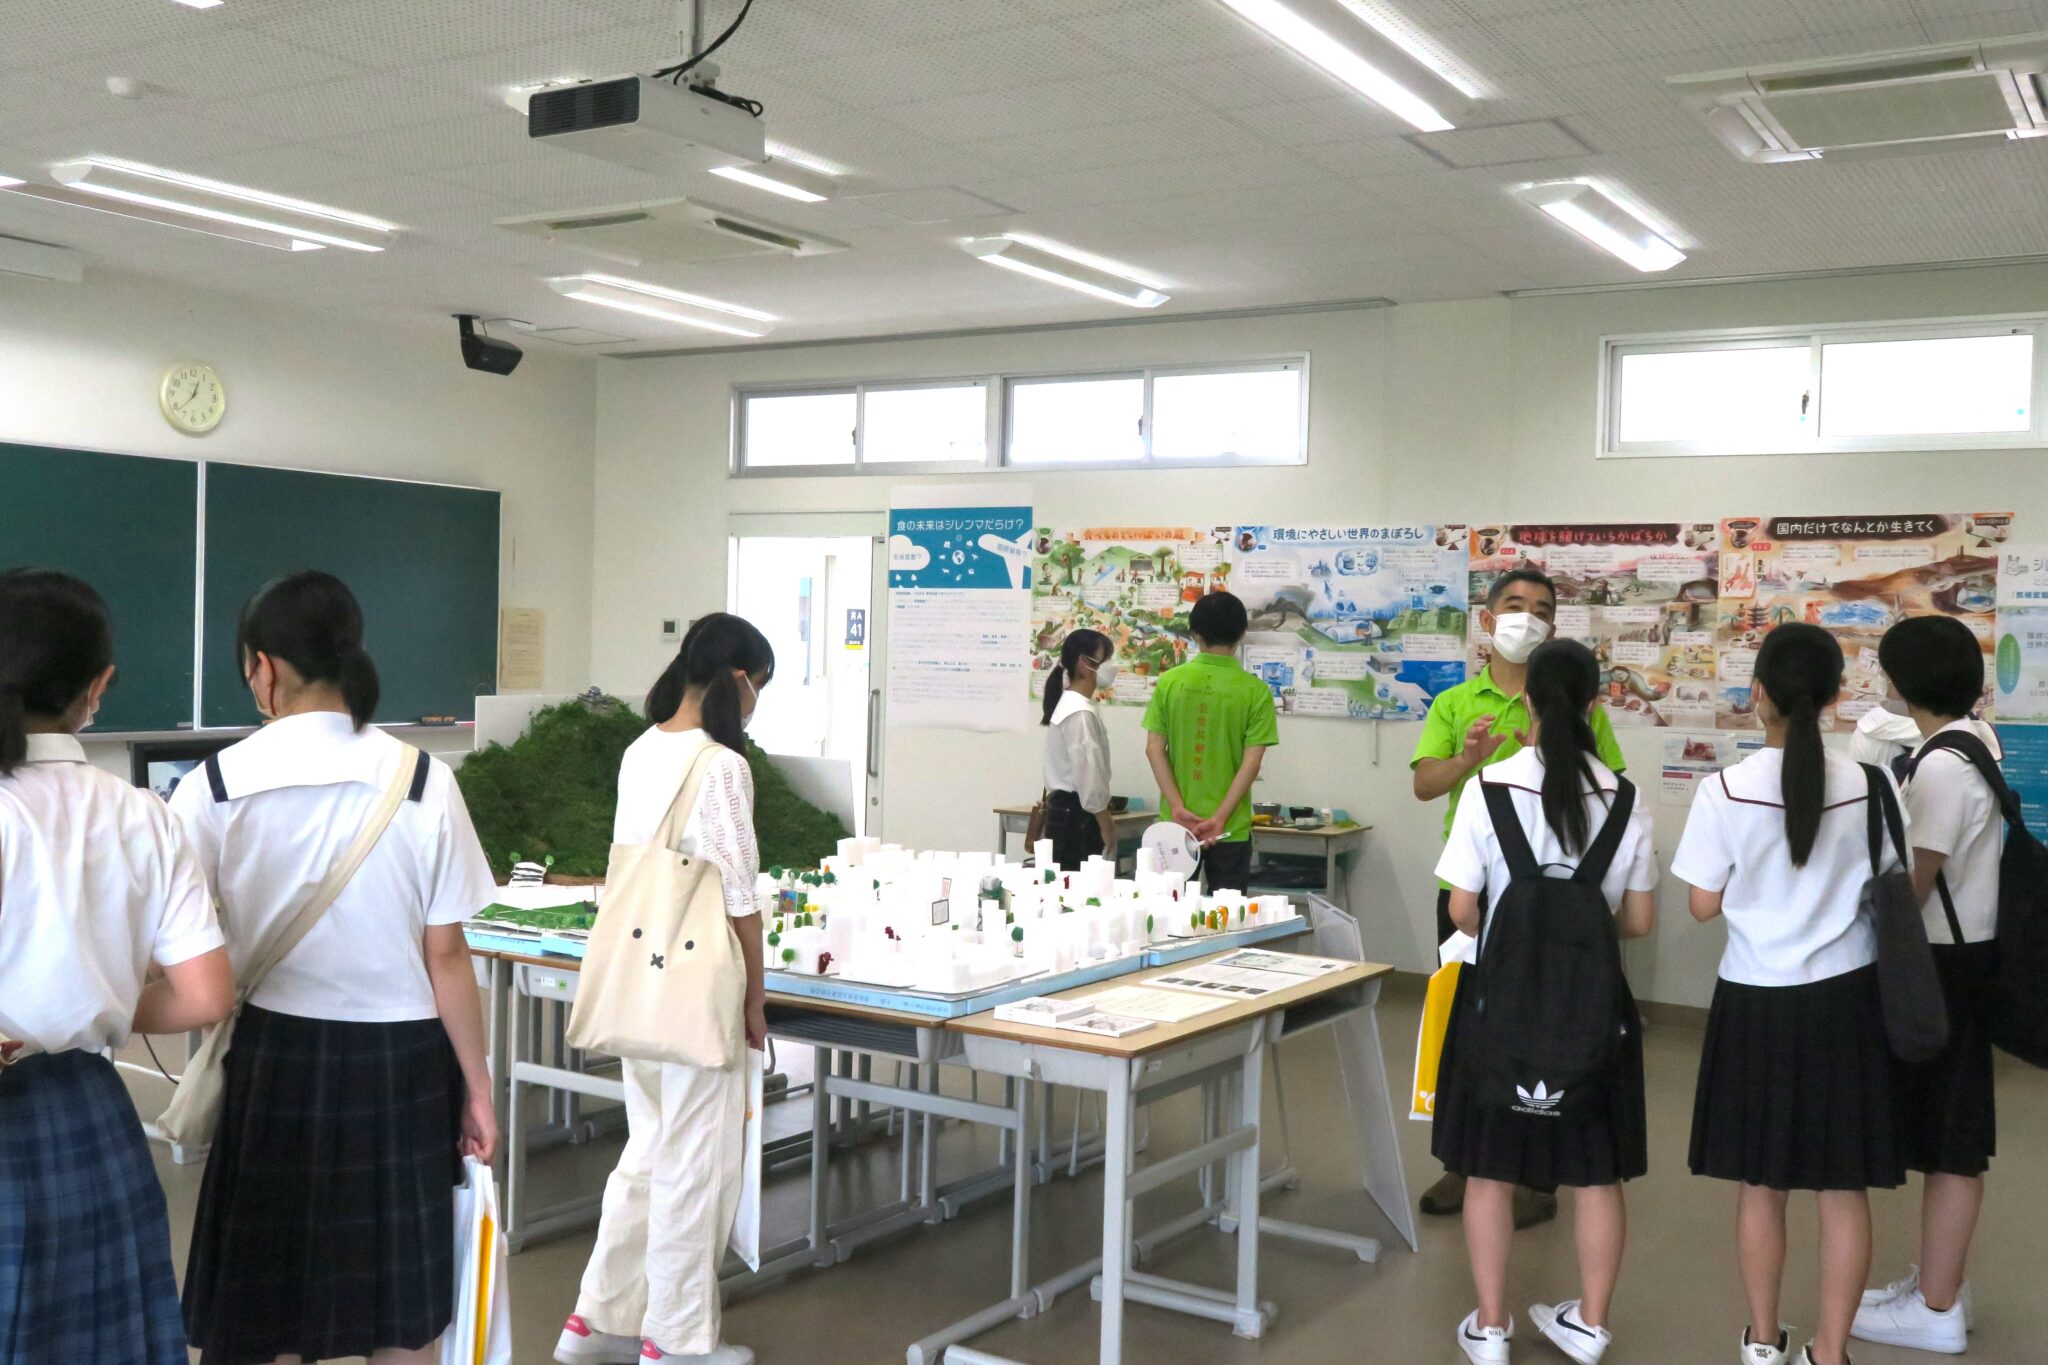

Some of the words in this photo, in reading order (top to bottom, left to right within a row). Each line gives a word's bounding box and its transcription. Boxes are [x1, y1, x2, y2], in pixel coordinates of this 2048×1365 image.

[1272, 526, 1425, 541] 環境にやさしい世界のまぼろし
[1776, 519, 1935, 535] 国内だけでなんとか生きてく
[850, 623, 862, 637] 41
[1511, 1105, 1561, 1117] adidas
